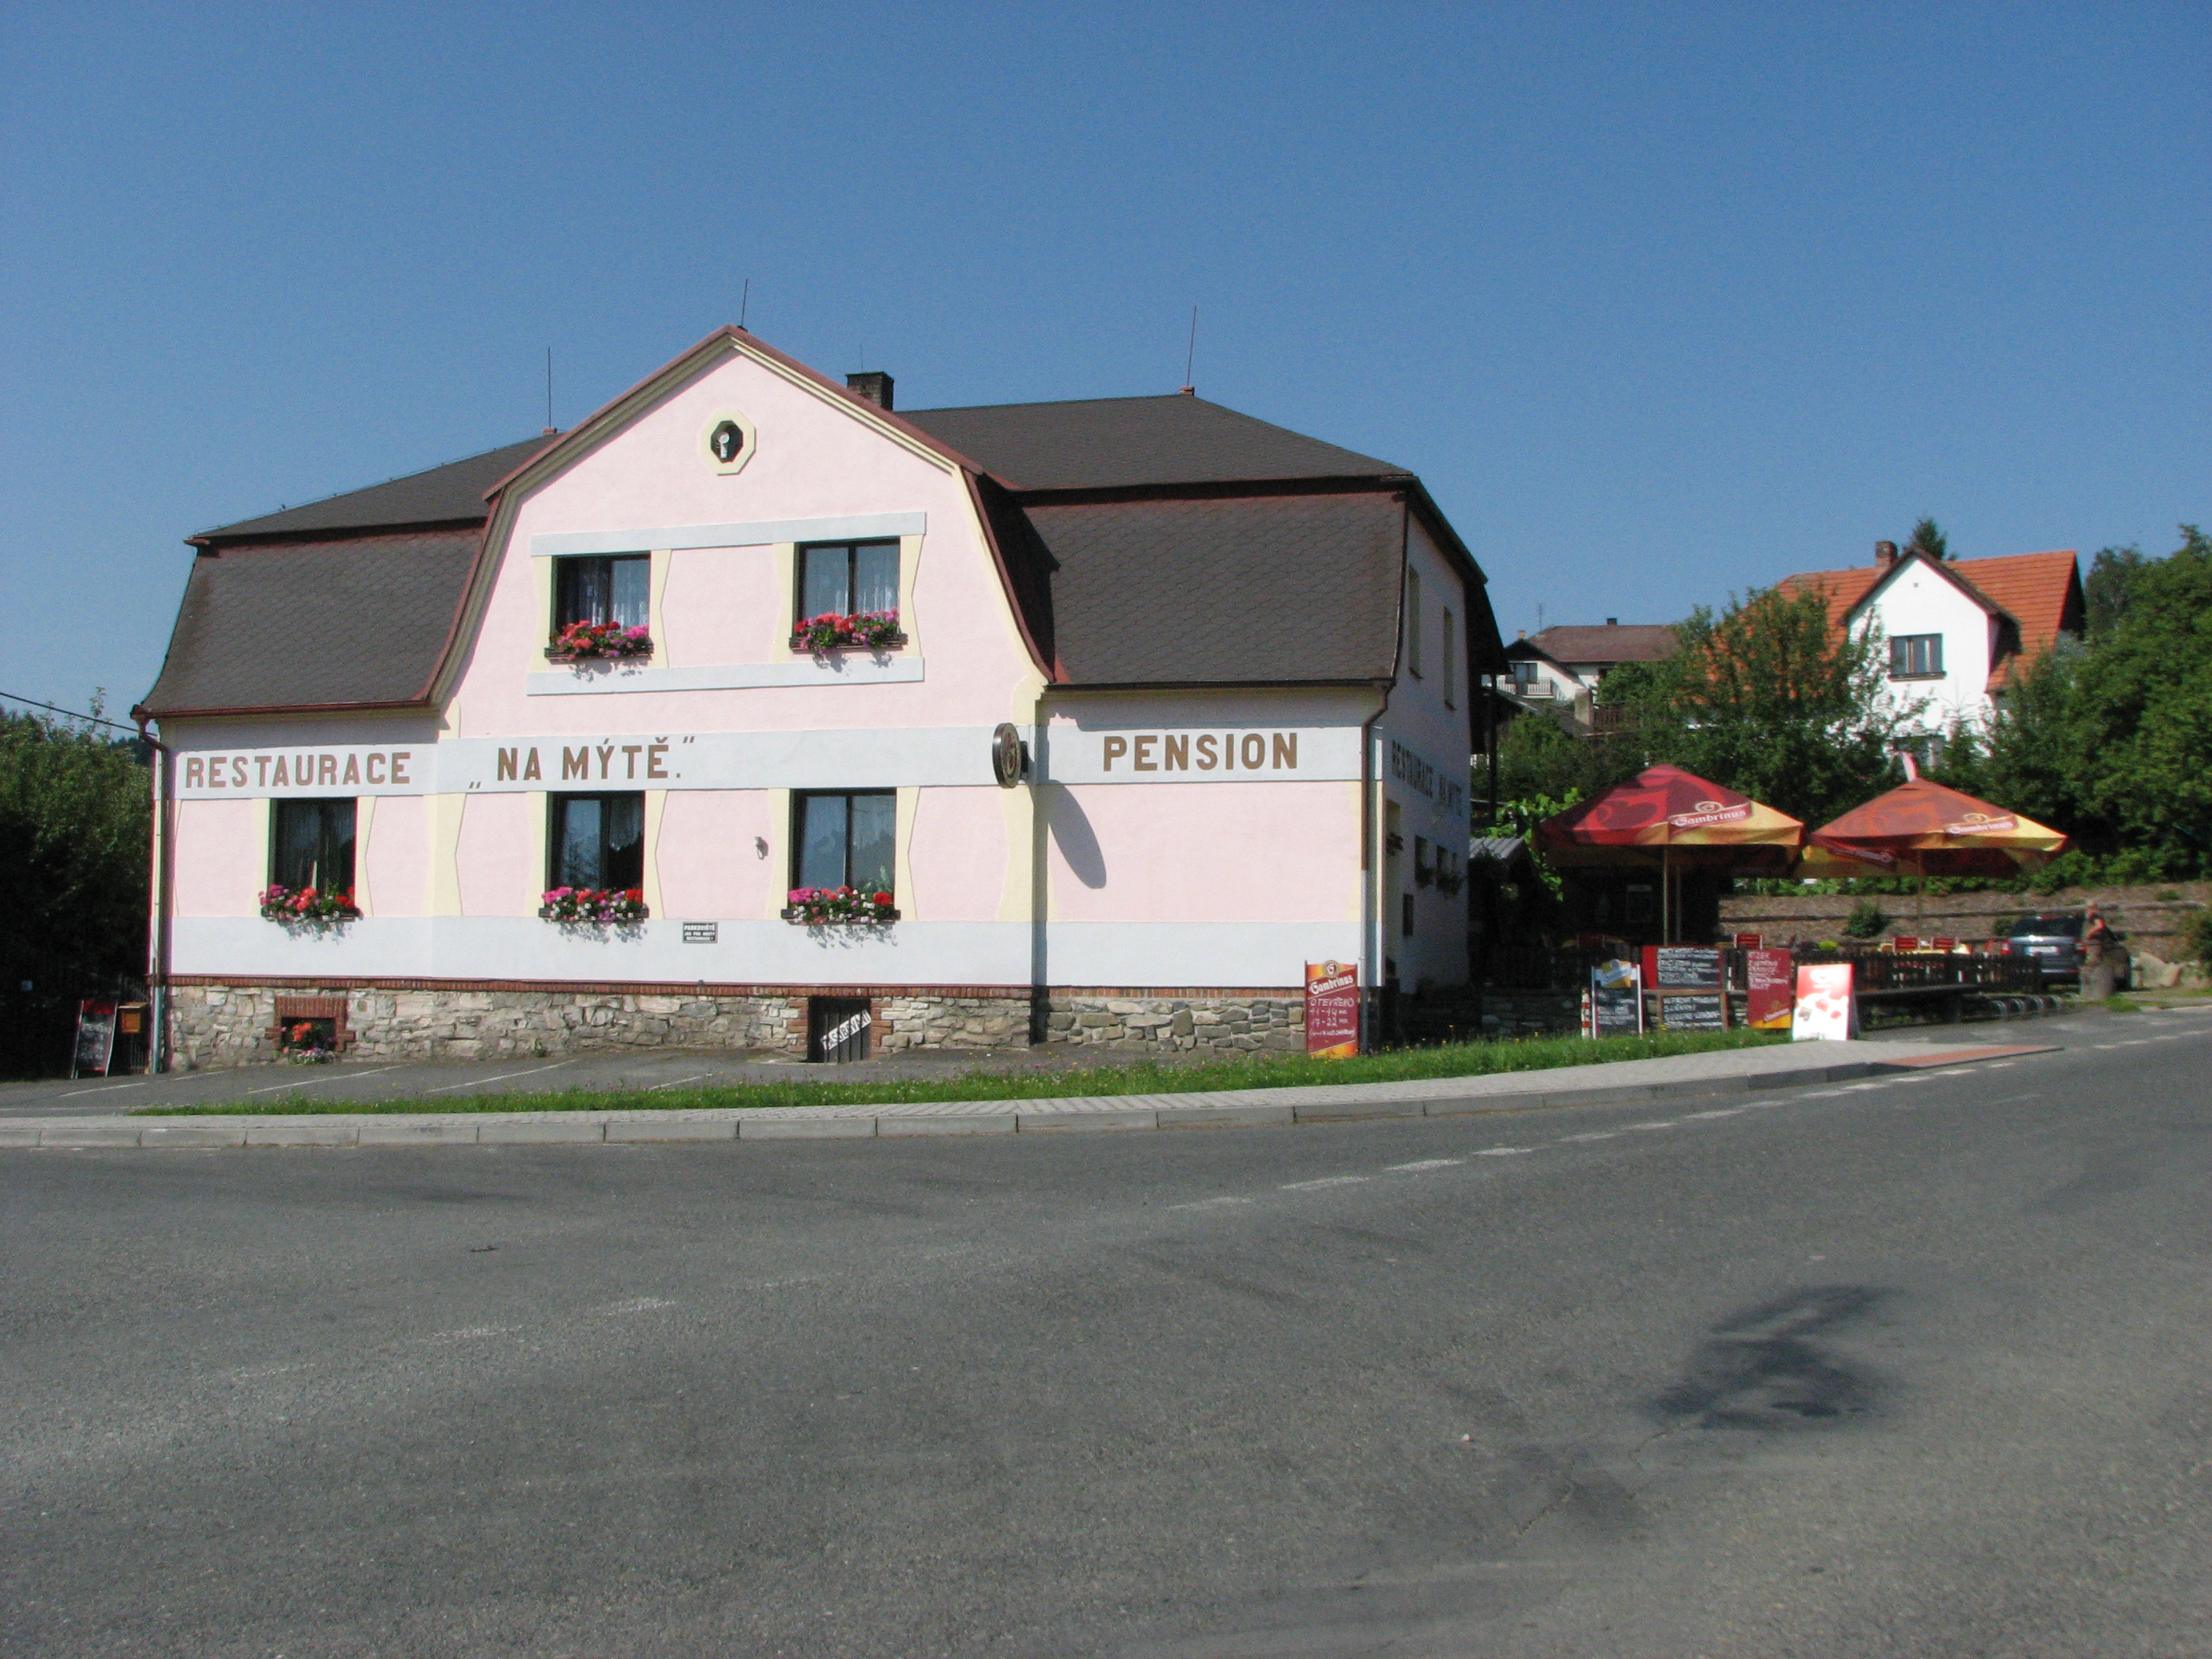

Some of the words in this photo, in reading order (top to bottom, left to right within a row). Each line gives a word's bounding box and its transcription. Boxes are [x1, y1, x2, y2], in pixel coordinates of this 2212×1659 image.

[1104, 733, 1298, 771] PENSION
[185, 752, 411, 788] RESTAURACE
[1671, 810, 1746, 827] Gambrinus
[1309, 975, 1353, 994] Gambrinus
[1310, 997, 1354, 1007] OTEVŘENO
